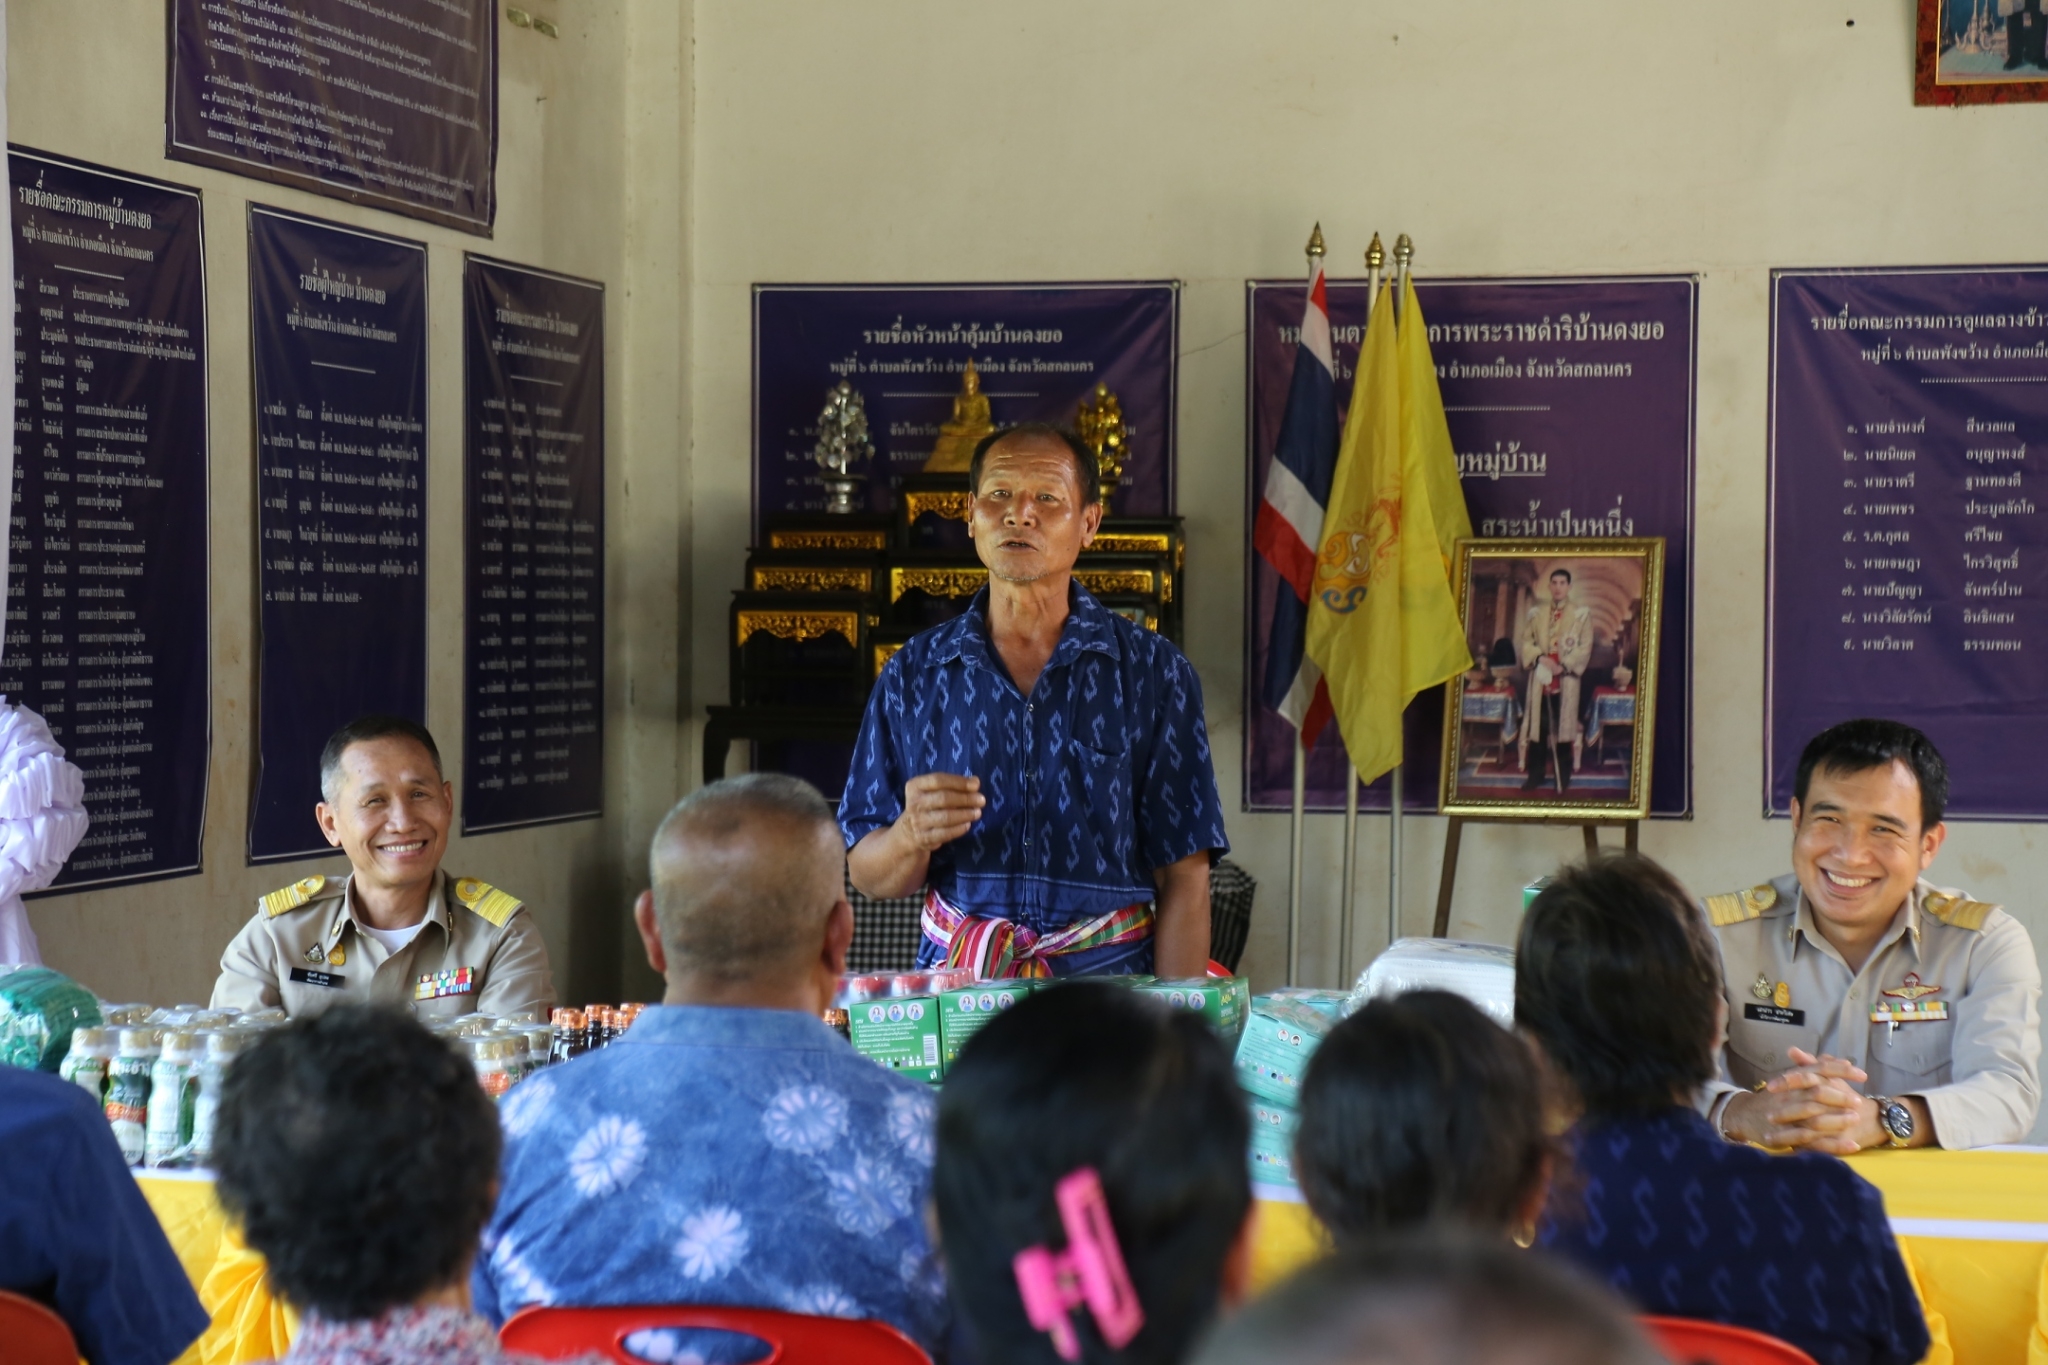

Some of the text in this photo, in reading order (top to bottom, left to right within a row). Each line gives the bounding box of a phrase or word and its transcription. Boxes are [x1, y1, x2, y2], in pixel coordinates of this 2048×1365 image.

[19, 169, 152, 230] รายชื่อคณะกรรมการหมู่บ้านดงยอ
[863, 314, 1063, 349] รายชื่อหัวหน้าคุ้มบ้านดงยอ
[829, 350, 858, 377] หมู่ที่
[869, 358, 944, 374] ตำบลพังขว้าง
[1007, 358, 1094, 374] จังหวัดสกลนคร
[1861, 336, 1891, 365] หมู่ที่
[1893, 349, 1902, 361] ๖
[1905, 342, 1989, 361] ตำบลพังขว้าง
[1449, 354, 1522, 380] อำเภอเมือง
[1525, 354, 1633, 380] จังหวัดสกลนคร
[1966, 417, 2016, 433] สีนวลแล
[1482, 494, 1634, 538] สระน้ำเป็นหนึ่ง
